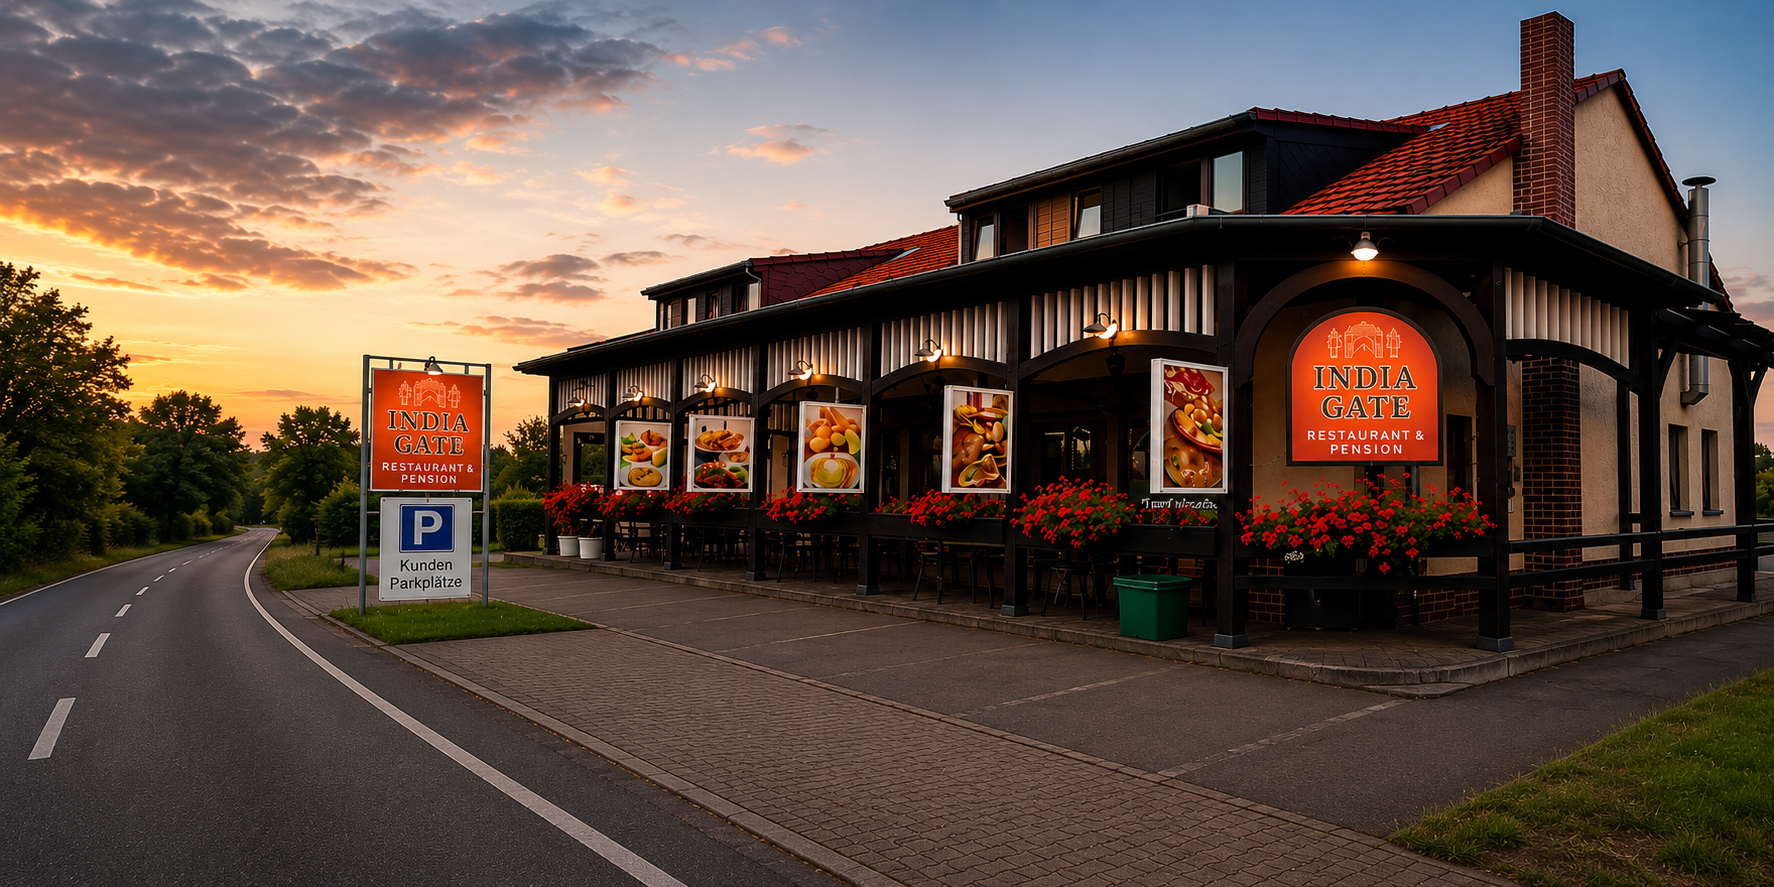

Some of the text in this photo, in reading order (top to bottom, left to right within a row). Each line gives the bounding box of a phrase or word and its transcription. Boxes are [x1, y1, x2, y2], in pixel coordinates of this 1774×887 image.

[1313, 365, 1417, 390] INDIA
[1321, 395, 1412, 419] GATE
[387, 409, 470, 433] INDIA
[1307, 430, 1425, 441] RESTAURANT &
[394, 434, 464, 456] GATE
[1330, 444, 1403, 455] PENSION
[382, 462, 474, 473] RESTAURANT &
[401, 474, 457, 484] PENSION
[413, 510, 444, 545] P
[400, 559, 453, 572] Kunden
[390, 575, 463, 592] Parkplätze
